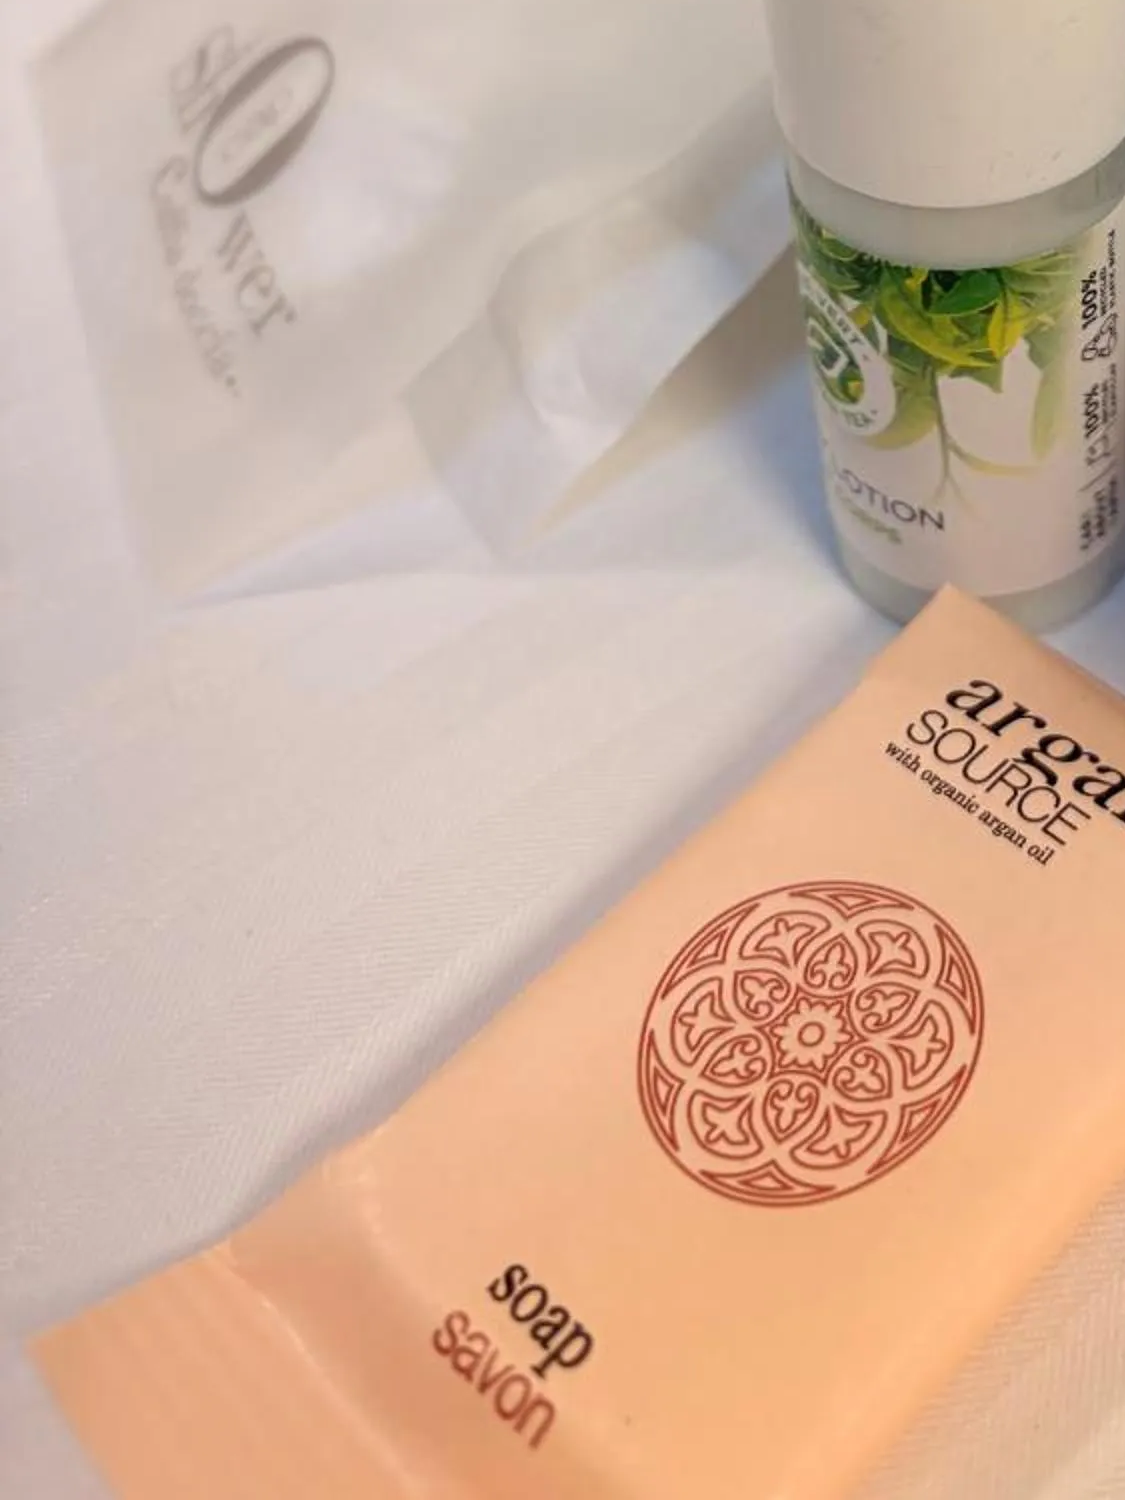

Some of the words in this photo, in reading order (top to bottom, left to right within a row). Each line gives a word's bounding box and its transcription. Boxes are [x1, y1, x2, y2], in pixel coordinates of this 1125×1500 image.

[1081, 270, 1098, 330] 100%
[1083, 383, 1100, 438] 100%
[885, 741, 921, 773] with
[920, 768, 980, 814] organic
[978, 810, 1028, 848] argan
[1026, 843, 1055, 866] oil
[906, 709, 1092, 846] SOURCE
[432, 1309, 556, 1450] savon
[486, 1263, 594, 1380] soap
